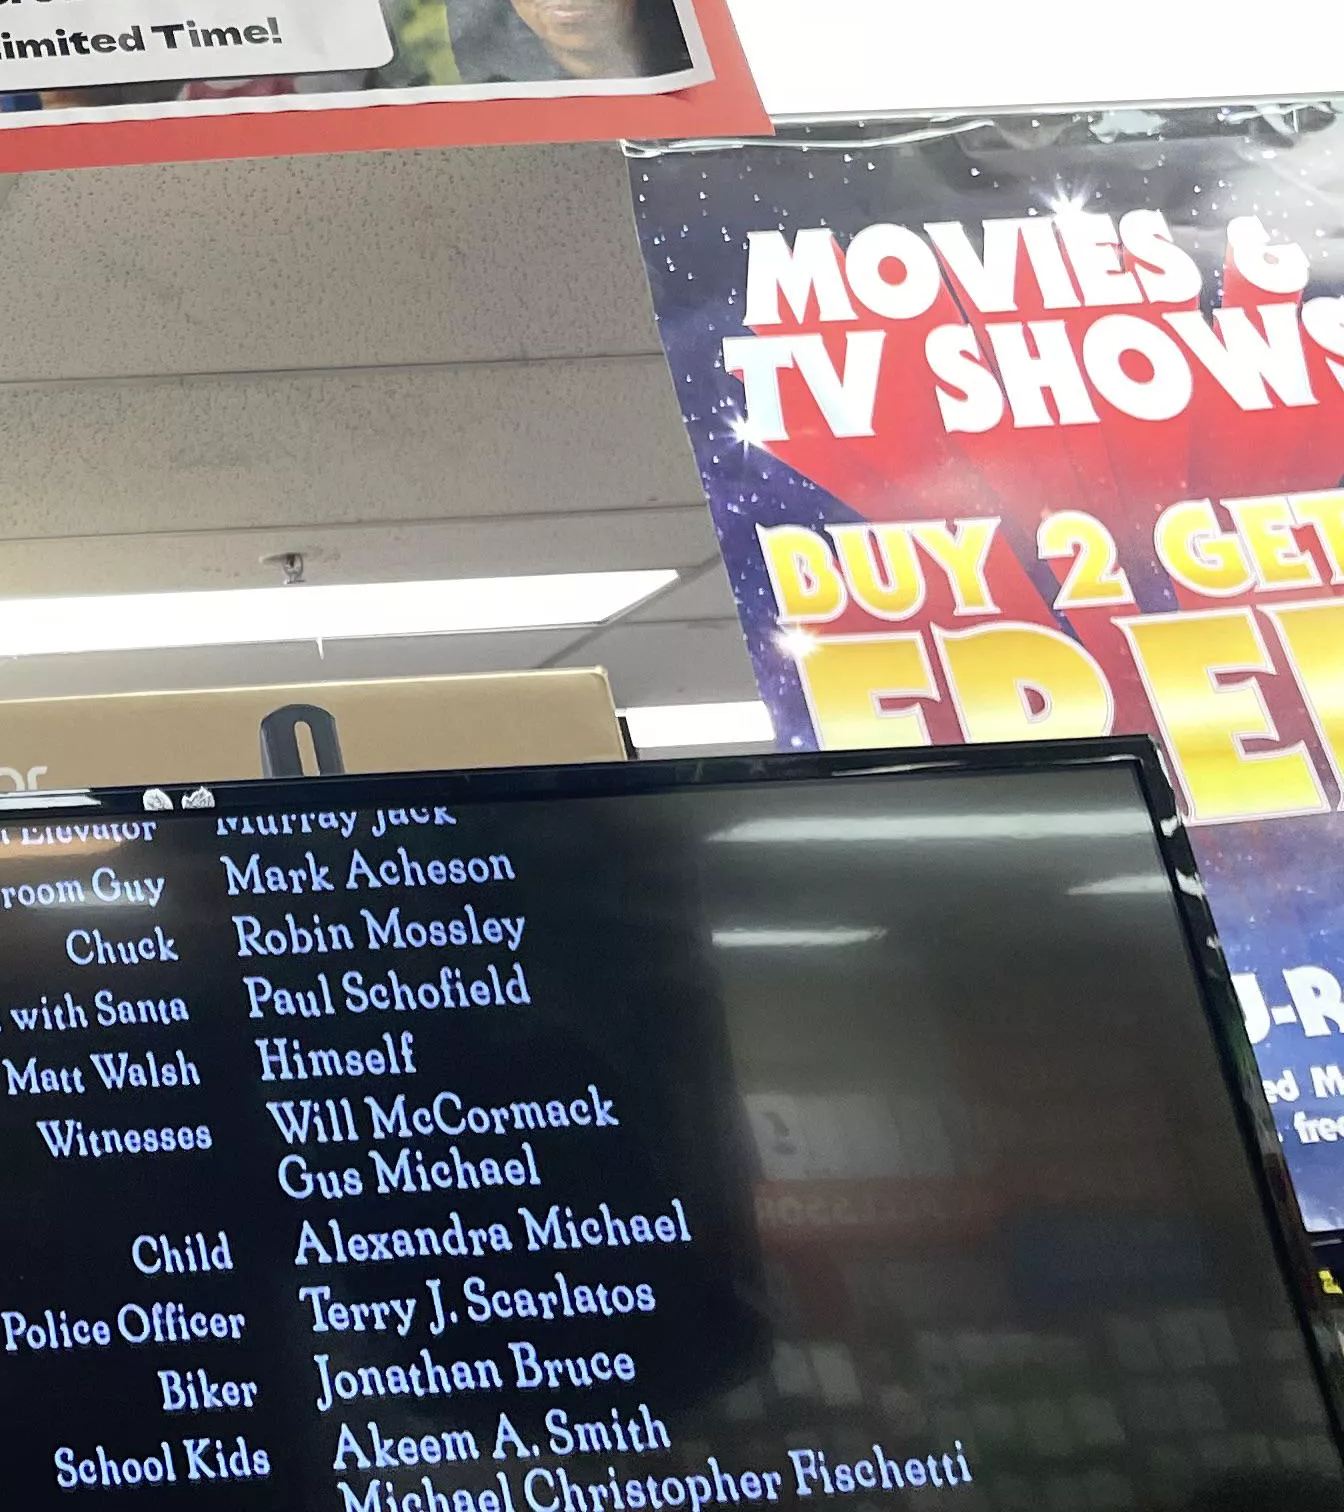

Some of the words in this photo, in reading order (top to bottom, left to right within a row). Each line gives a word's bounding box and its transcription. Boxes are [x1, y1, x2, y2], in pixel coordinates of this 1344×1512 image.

[150, 17, 283, 52] Time!
[741, 208, 1203, 328] MOVIES
[721, 328, 887, 443] TV
[755, 515, 1003, 627] BUY
[1034, 509, 1135, 610] 2
[90, 866, 166, 908] Guy
[219, 850, 336, 896] Mark
[345, 845, 516, 890] Acheson
[64, 926, 181, 967] Chuck
[231, 912, 354, 958] Robin
[359, 904, 527, 952] Mossley
[10, 995, 88, 1031] with
[94, 990, 190, 1026] Santa
[242, 974, 336, 1019] Paul
[341, 963, 532, 1017] Schofield
[2, 1056, 85, 1097] Matt
[89, 1049, 202, 1090] Walsh
[254, 1031, 418, 1082] Himself
[35, 1117, 214, 1159] Witnesses
[265, 1096, 360, 1146] Will
[363, 1084, 620, 1144] McCormack
[276, 1152, 364, 1200] Gus
[367, 1142, 542, 1195] Michael
[130, 1228, 234, 1275] Child
[293, 1210, 513, 1267] Alexandra
[517, 1199, 693, 1253] Michael
[0, 1309, 112, 1354] Police
[116, 1301, 247, 1346] Officer
[298, 1283, 417, 1340] Terry
[424, 1277, 459, 1337] J.
[461, 1271, 657, 1323] Scarlatos
[155, 1368, 258, 1413] Biker
[312, 1347, 504, 1413] Jonathan
[507, 1341, 637, 1392] Bruce
[53, 1440, 176, 1489] School
[183, 1435, 272, 1482] Kids
[331, 1422, 482, 1473] Akeem
[491, 1412, 541, 1461] A.
[543, 1403, 674, 1456] Smith
[335, 1472, 515, 1512] Michael
[522, 1456, 784, 1512] Christopher
[785, 1439, 975, 1501] Fischetti
